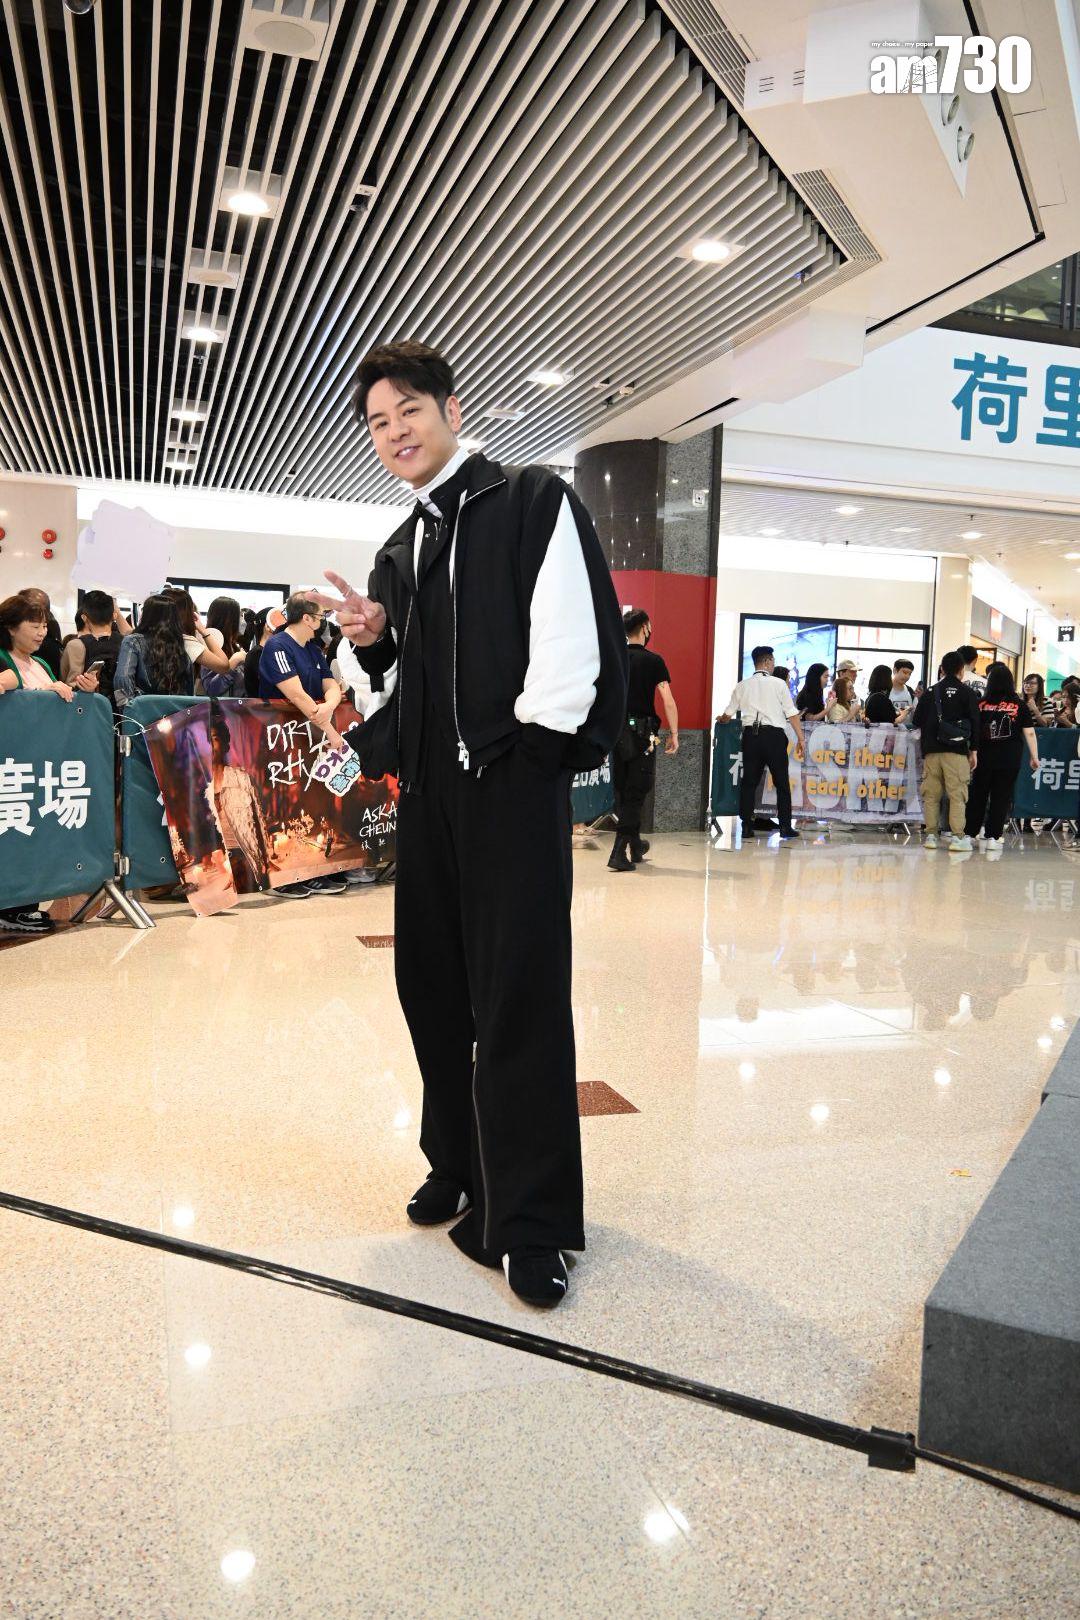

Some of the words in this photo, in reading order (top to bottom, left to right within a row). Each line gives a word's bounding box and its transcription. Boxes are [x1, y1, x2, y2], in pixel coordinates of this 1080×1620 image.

[951, 351, 1080, 449] 荷里
[811, 750, 847, 767] are
[854, 746, 906, 769] there
[0, 757, 91, 836] 廣場
[805, 776, 849, 798] each
[856, 779, 907, 800] other
[362, 800, 397, 823] ASKA
[360, 821, 397, 838] CHEUN
